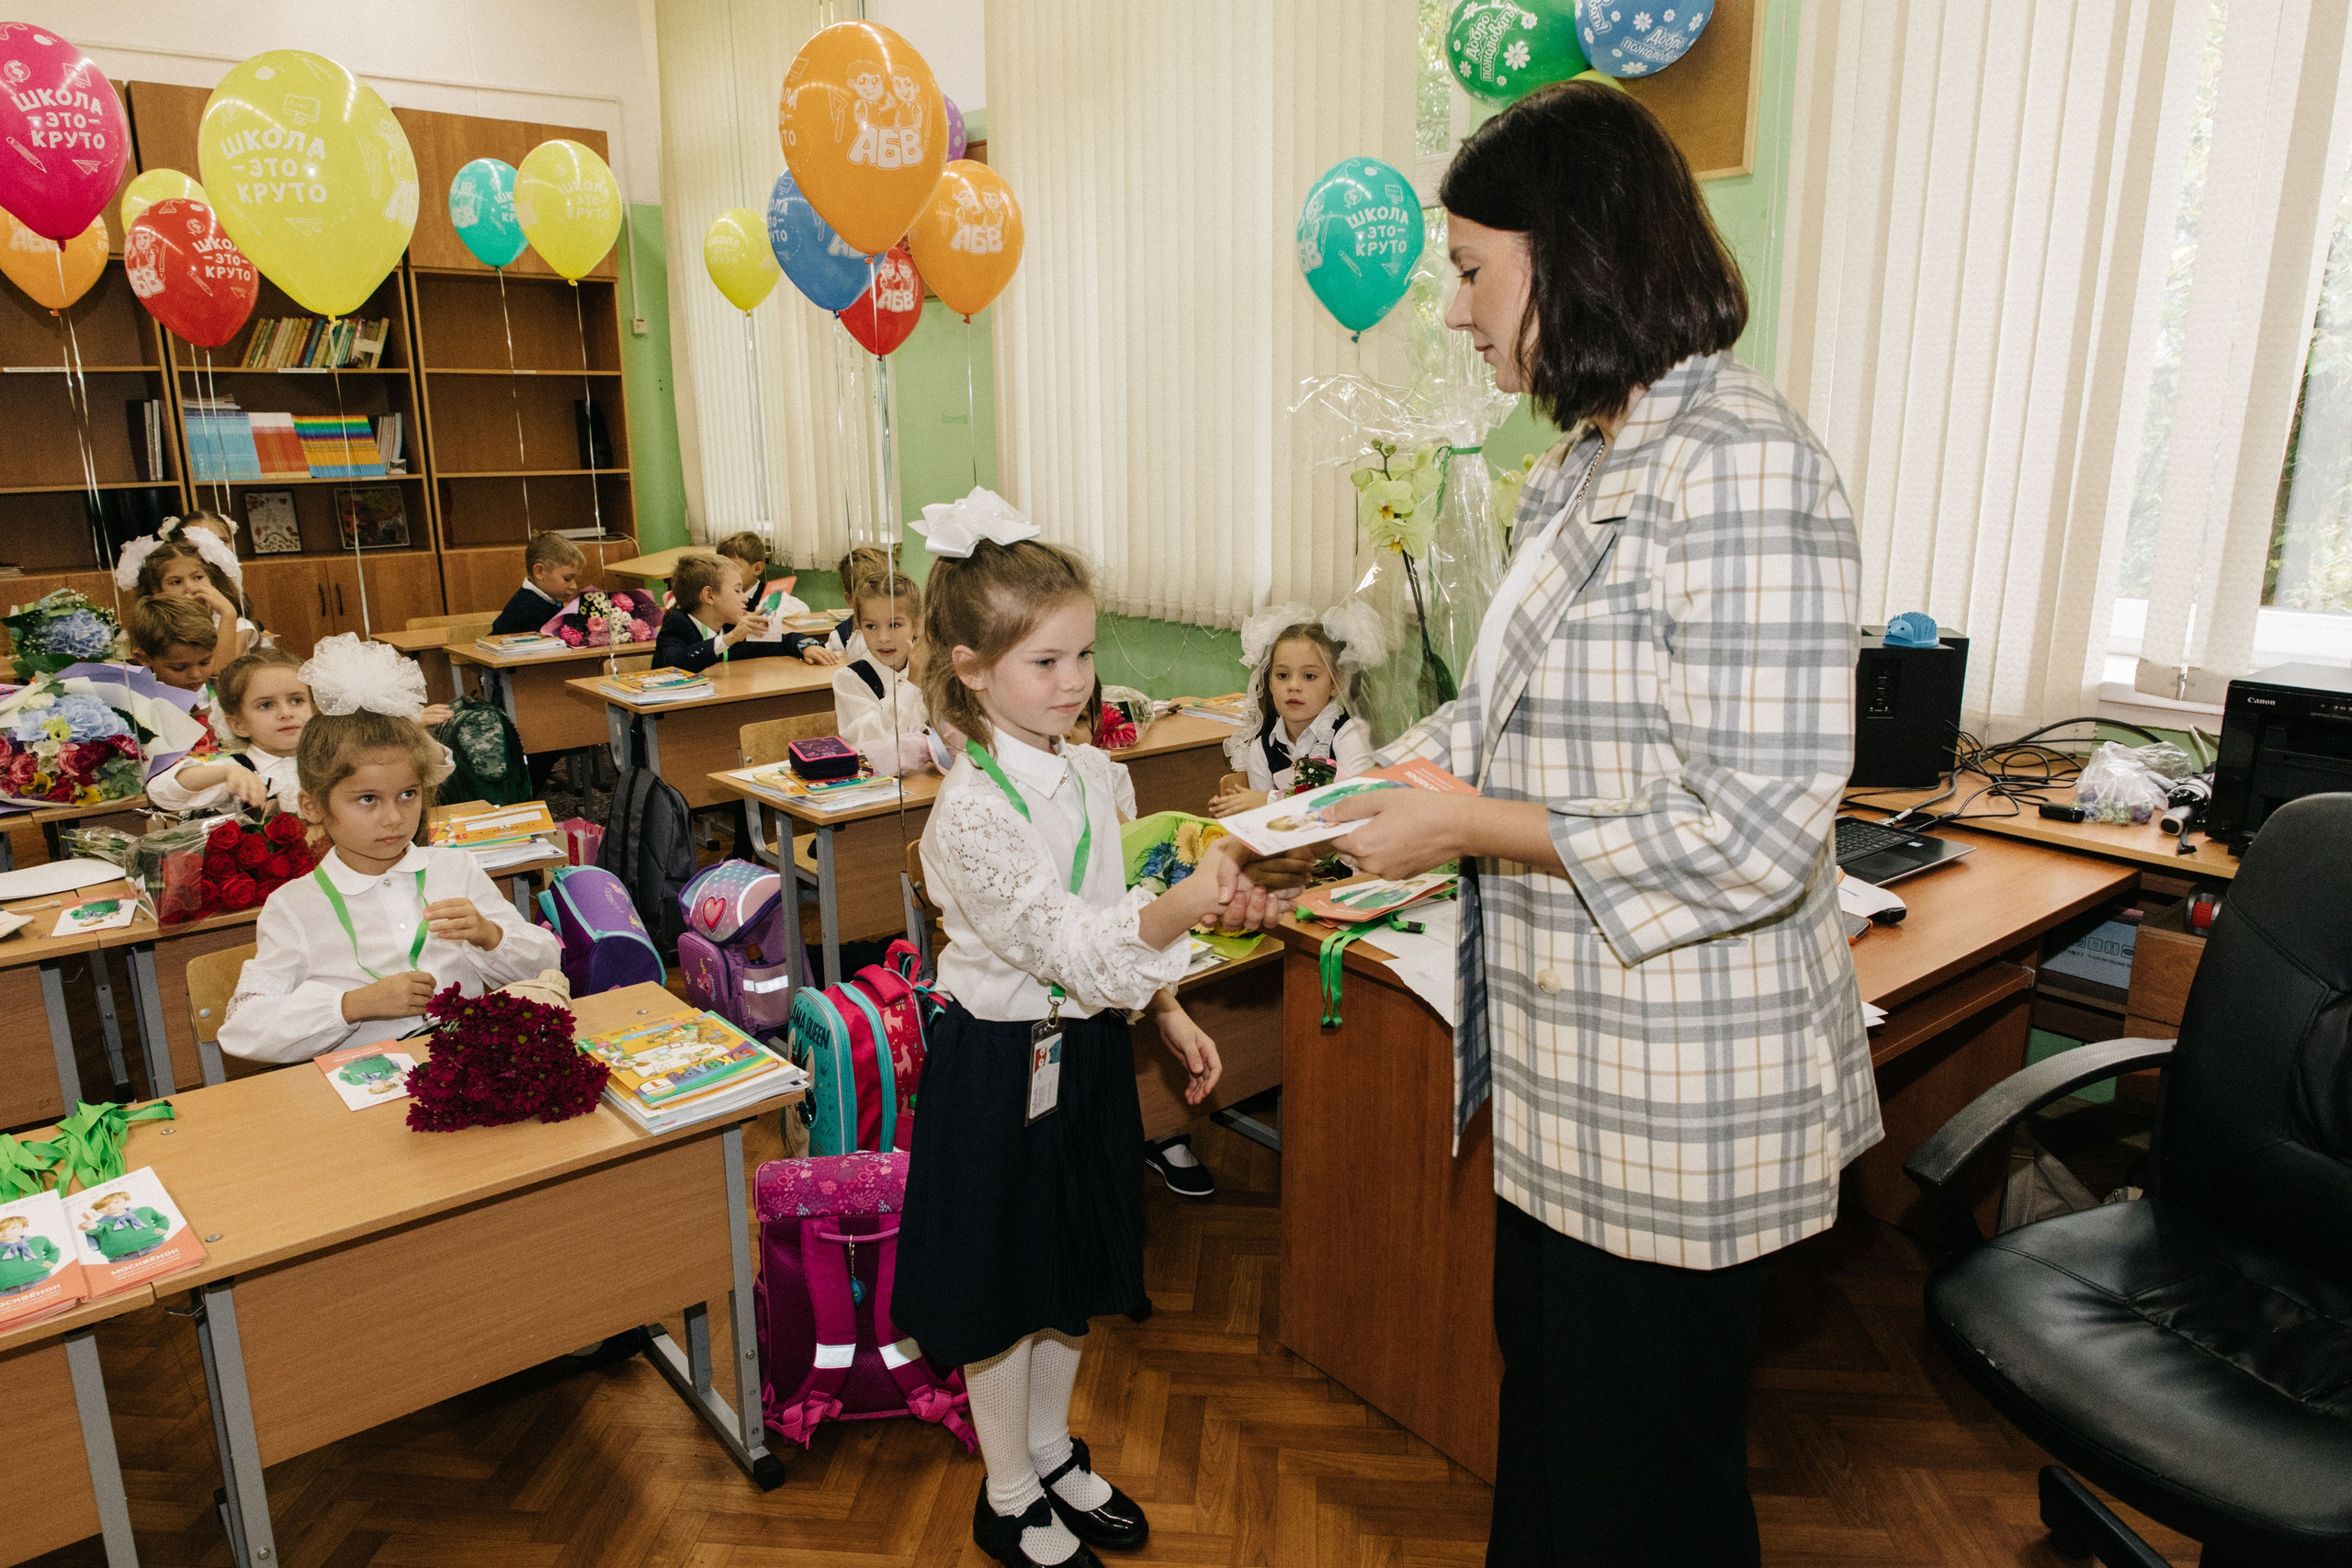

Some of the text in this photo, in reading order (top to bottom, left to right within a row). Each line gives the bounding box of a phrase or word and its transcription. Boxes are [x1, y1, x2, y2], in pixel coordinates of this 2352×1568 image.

[1464, 13, 1491, 62] Добро
[1644, 27, 1688, 50] Добро
[11, 88, 103, 116] ШКОЛА
[30, 130, 106, 150] КРУТО
[220, 128, 326, 160] ШКОЛА
[847, 126, 924, 171] АБВ
[236, 182, 327, 204] КРУТО
[557, 180, 609, 197] ШКОЛА
[566, 207, 609, 220] КРУТО
[1346, 206, 1408, 230] ШКОЛА
[950, 224, 1005, 255] АБВ
[1355, 240, 1408, 257] КРУТО
[205, 265, 252, 282] КРУТО
[876, 288, 915, 312] АБВ
[2247, 696, 2276, 706] Canon
[667, 1046, 761, 1084] БУКВАРЬ
[110, 1247, 180, 1276] МОСКВЁНОК
[0, 1282, 62, 1308] ОСКВЁНОК
